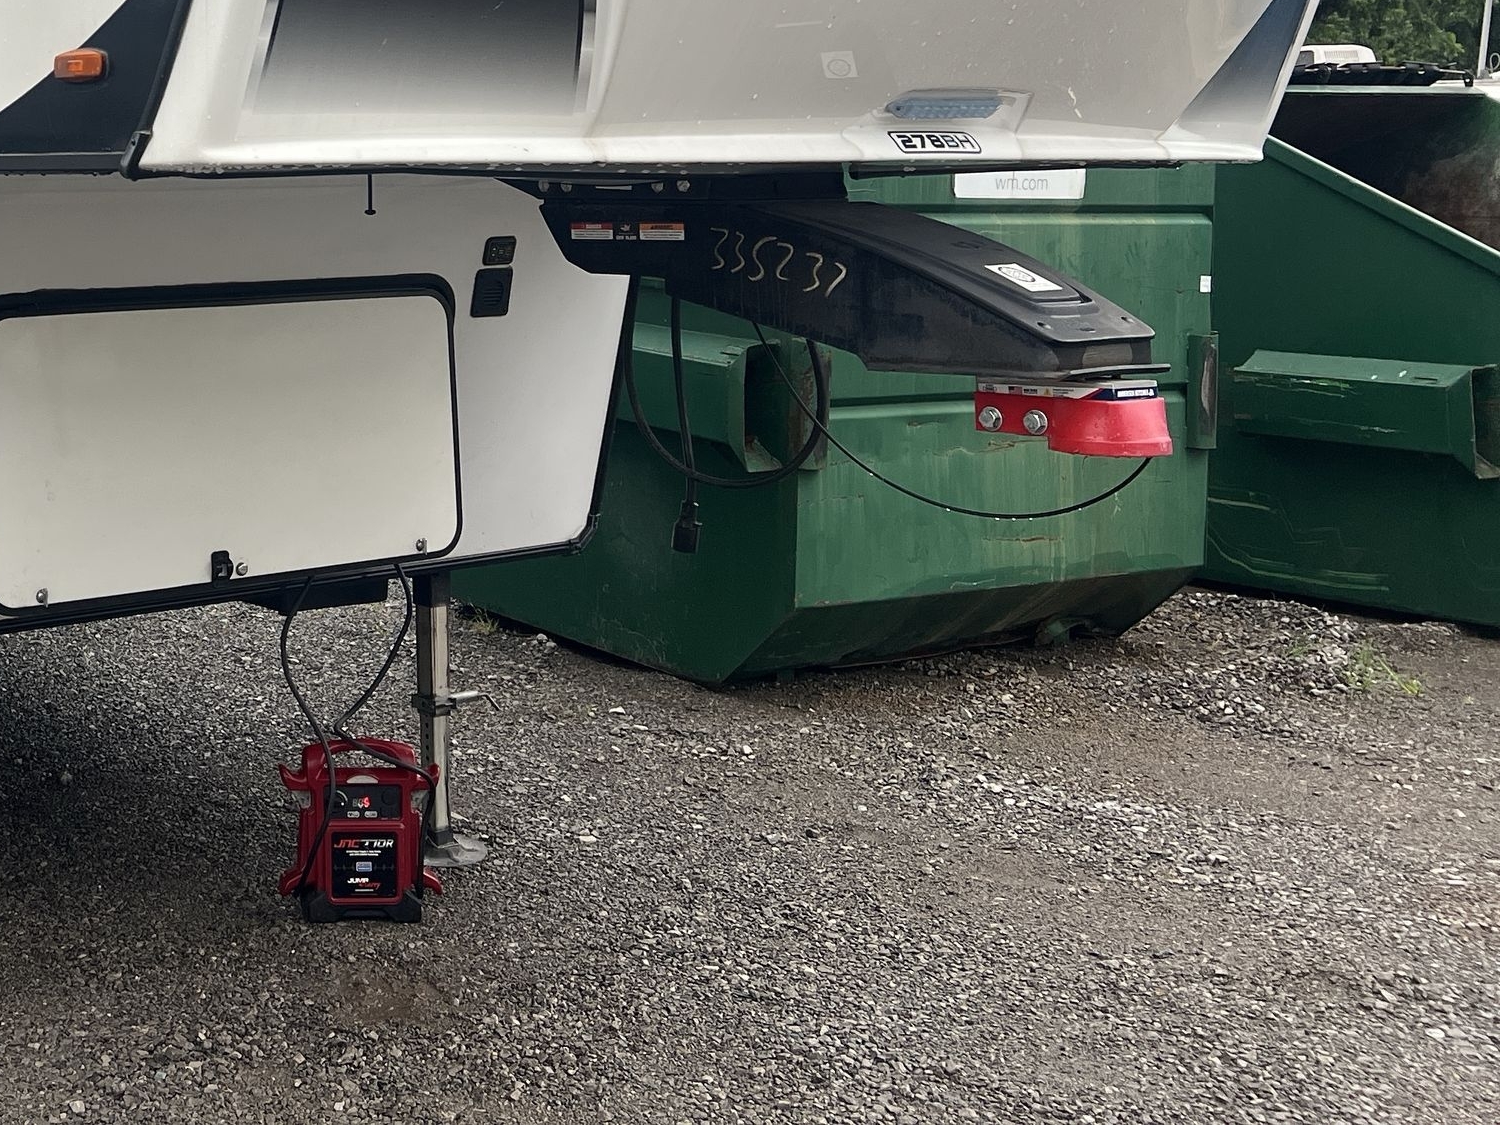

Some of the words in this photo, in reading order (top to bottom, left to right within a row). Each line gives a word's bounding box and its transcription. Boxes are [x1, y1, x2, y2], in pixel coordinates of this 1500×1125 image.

[896, 134, 975, 150] 278BH
[995, 177, 1048, 191] wm.com
[709, 227, 847, 298] 335237
